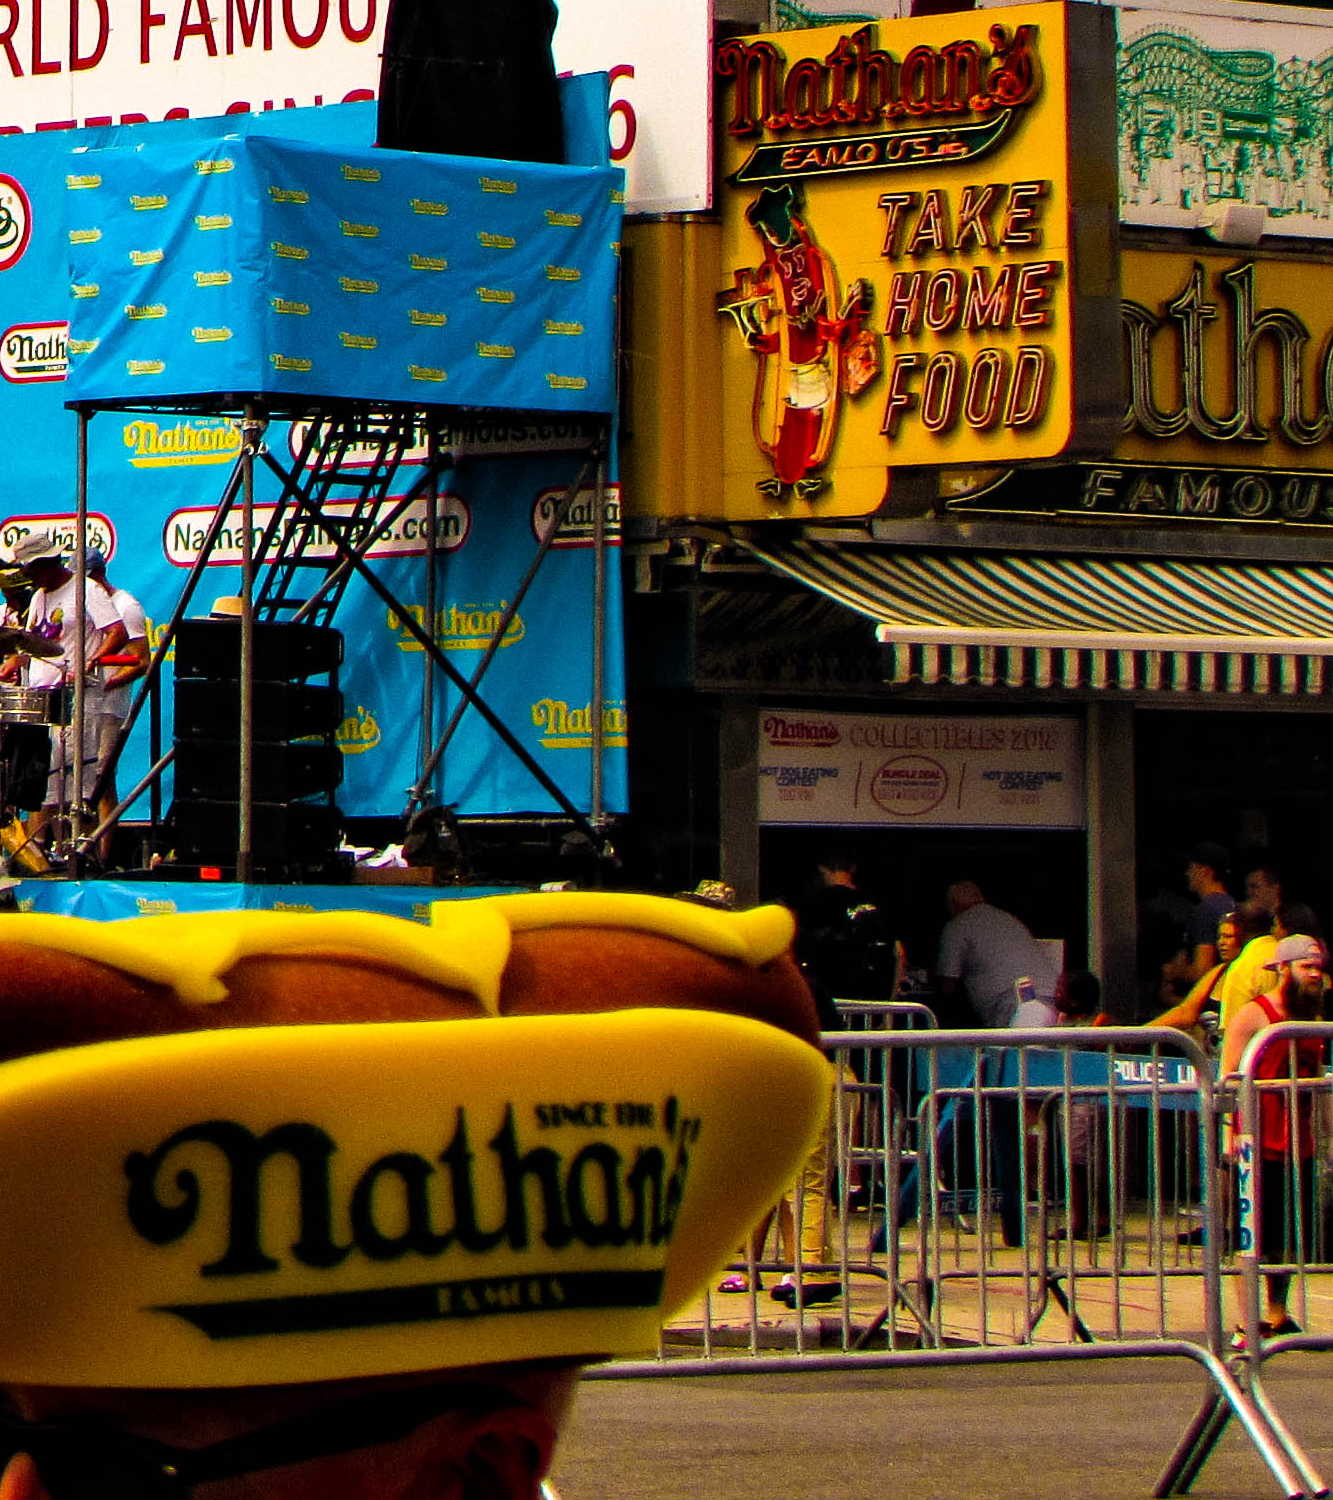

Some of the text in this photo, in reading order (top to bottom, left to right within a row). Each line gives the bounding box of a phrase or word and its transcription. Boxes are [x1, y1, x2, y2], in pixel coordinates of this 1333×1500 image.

[717, 24, 1041, 137] Nathan's
[878, 180, 1053, 258] TAKE
[884, 261, 1062, 337] HOME
[879, 345, 1049, 437] FOOD
[1083, 469, 1333, 517] FAMOU
[763, 715, 840, 743] Nathan's
[534, 1102, 610, 1132] SINCE
